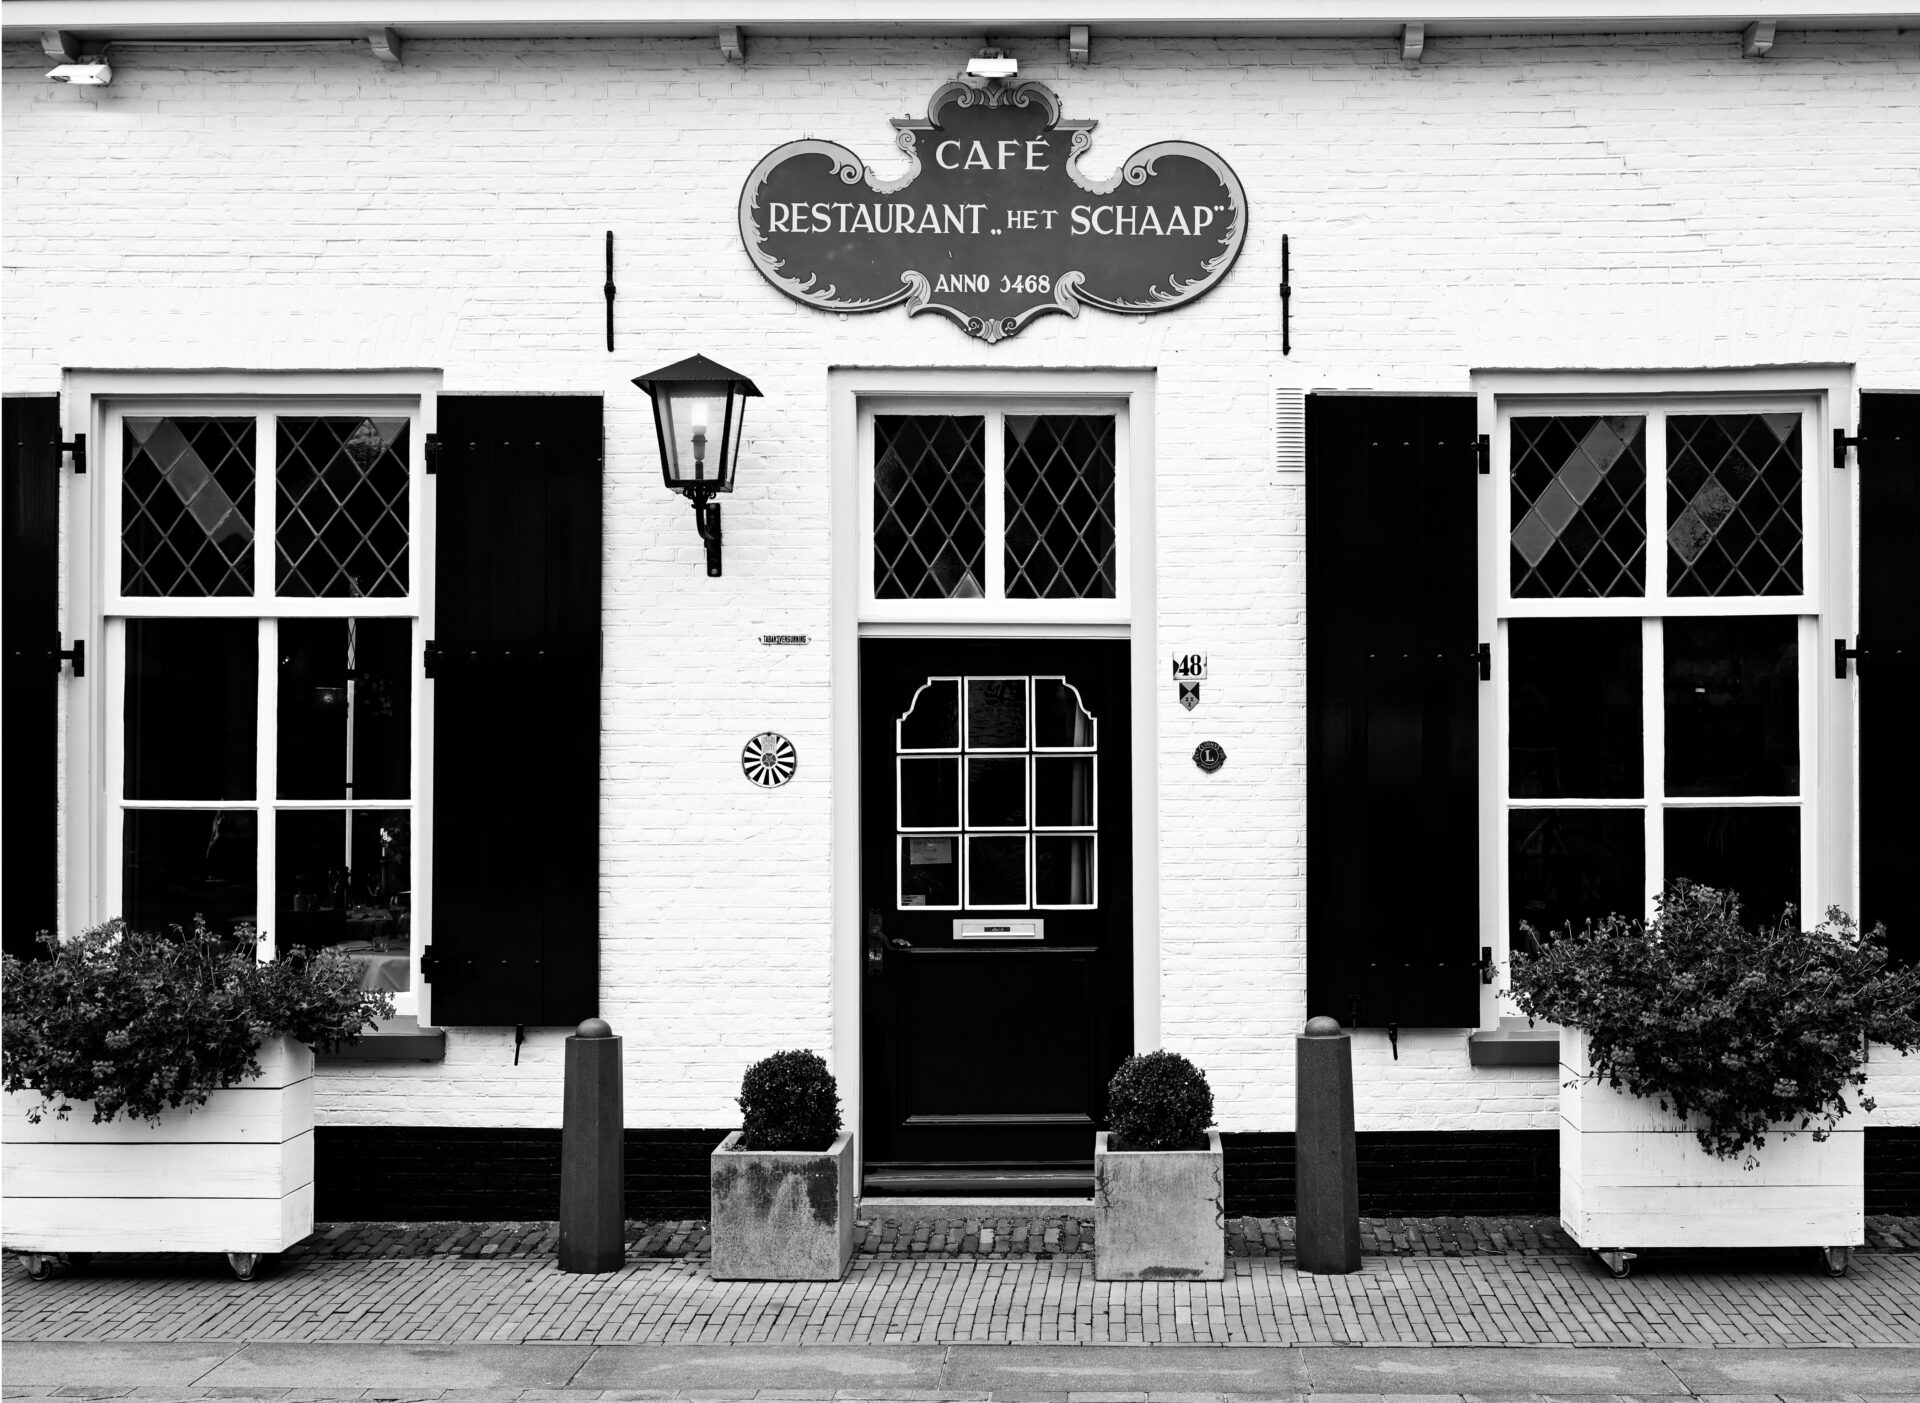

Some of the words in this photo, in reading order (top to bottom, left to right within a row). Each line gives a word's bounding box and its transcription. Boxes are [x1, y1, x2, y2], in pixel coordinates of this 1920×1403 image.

[935, 136, 1050, 171] CAFÉ
[768, 202, 988, 234] RESTAURANT
[934, 273, 990, 293] ANNO
[1178, 654, 1202, 676] 48
[1205, 750, 1215, 762] L
